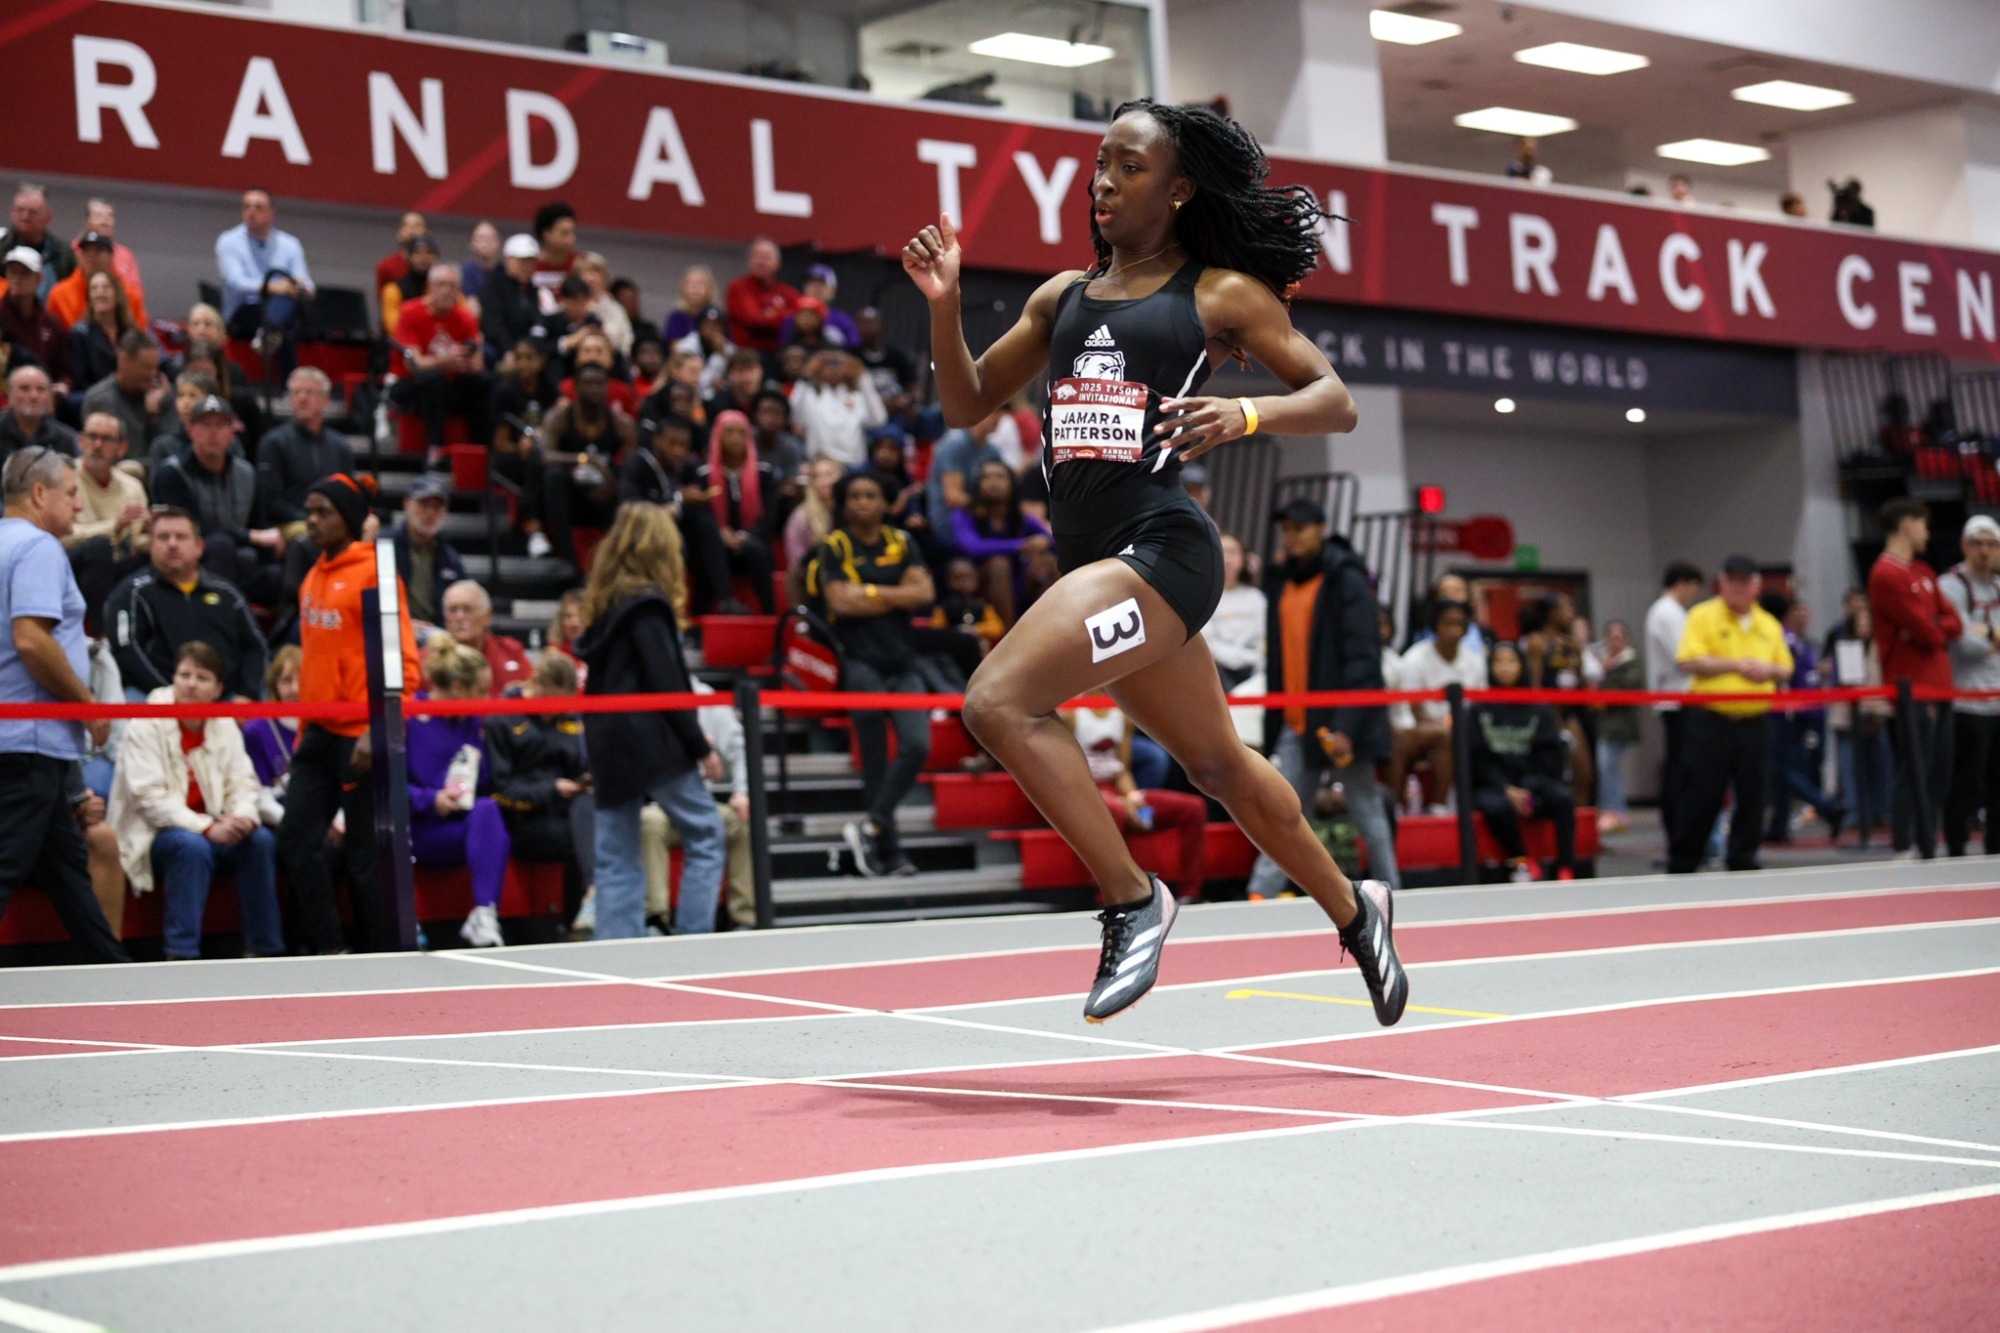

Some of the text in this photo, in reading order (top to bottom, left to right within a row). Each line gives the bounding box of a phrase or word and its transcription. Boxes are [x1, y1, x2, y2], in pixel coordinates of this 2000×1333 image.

[72, 34, 814, 219] RANDAL
[917, 138, 1352, 274] TYN
[1431, 202, 1777, 319] TRACK
[1084, 338, 1115, 347] adidas
[1384, 335, 1426, 372] IN
[1442, 341, 1514, 380] THE
[1529, 349, 1648, 391] WORLD
[1080, 383, 1139, 397] 2025 TYSON
[1078, 393, 1137, 406] INVITATIONAL
[1061, 411, 1121, 425] JAMARA
[1054, 427, 1137, 441] PATTERSON
[1092, 610, 1140, 649] 3
